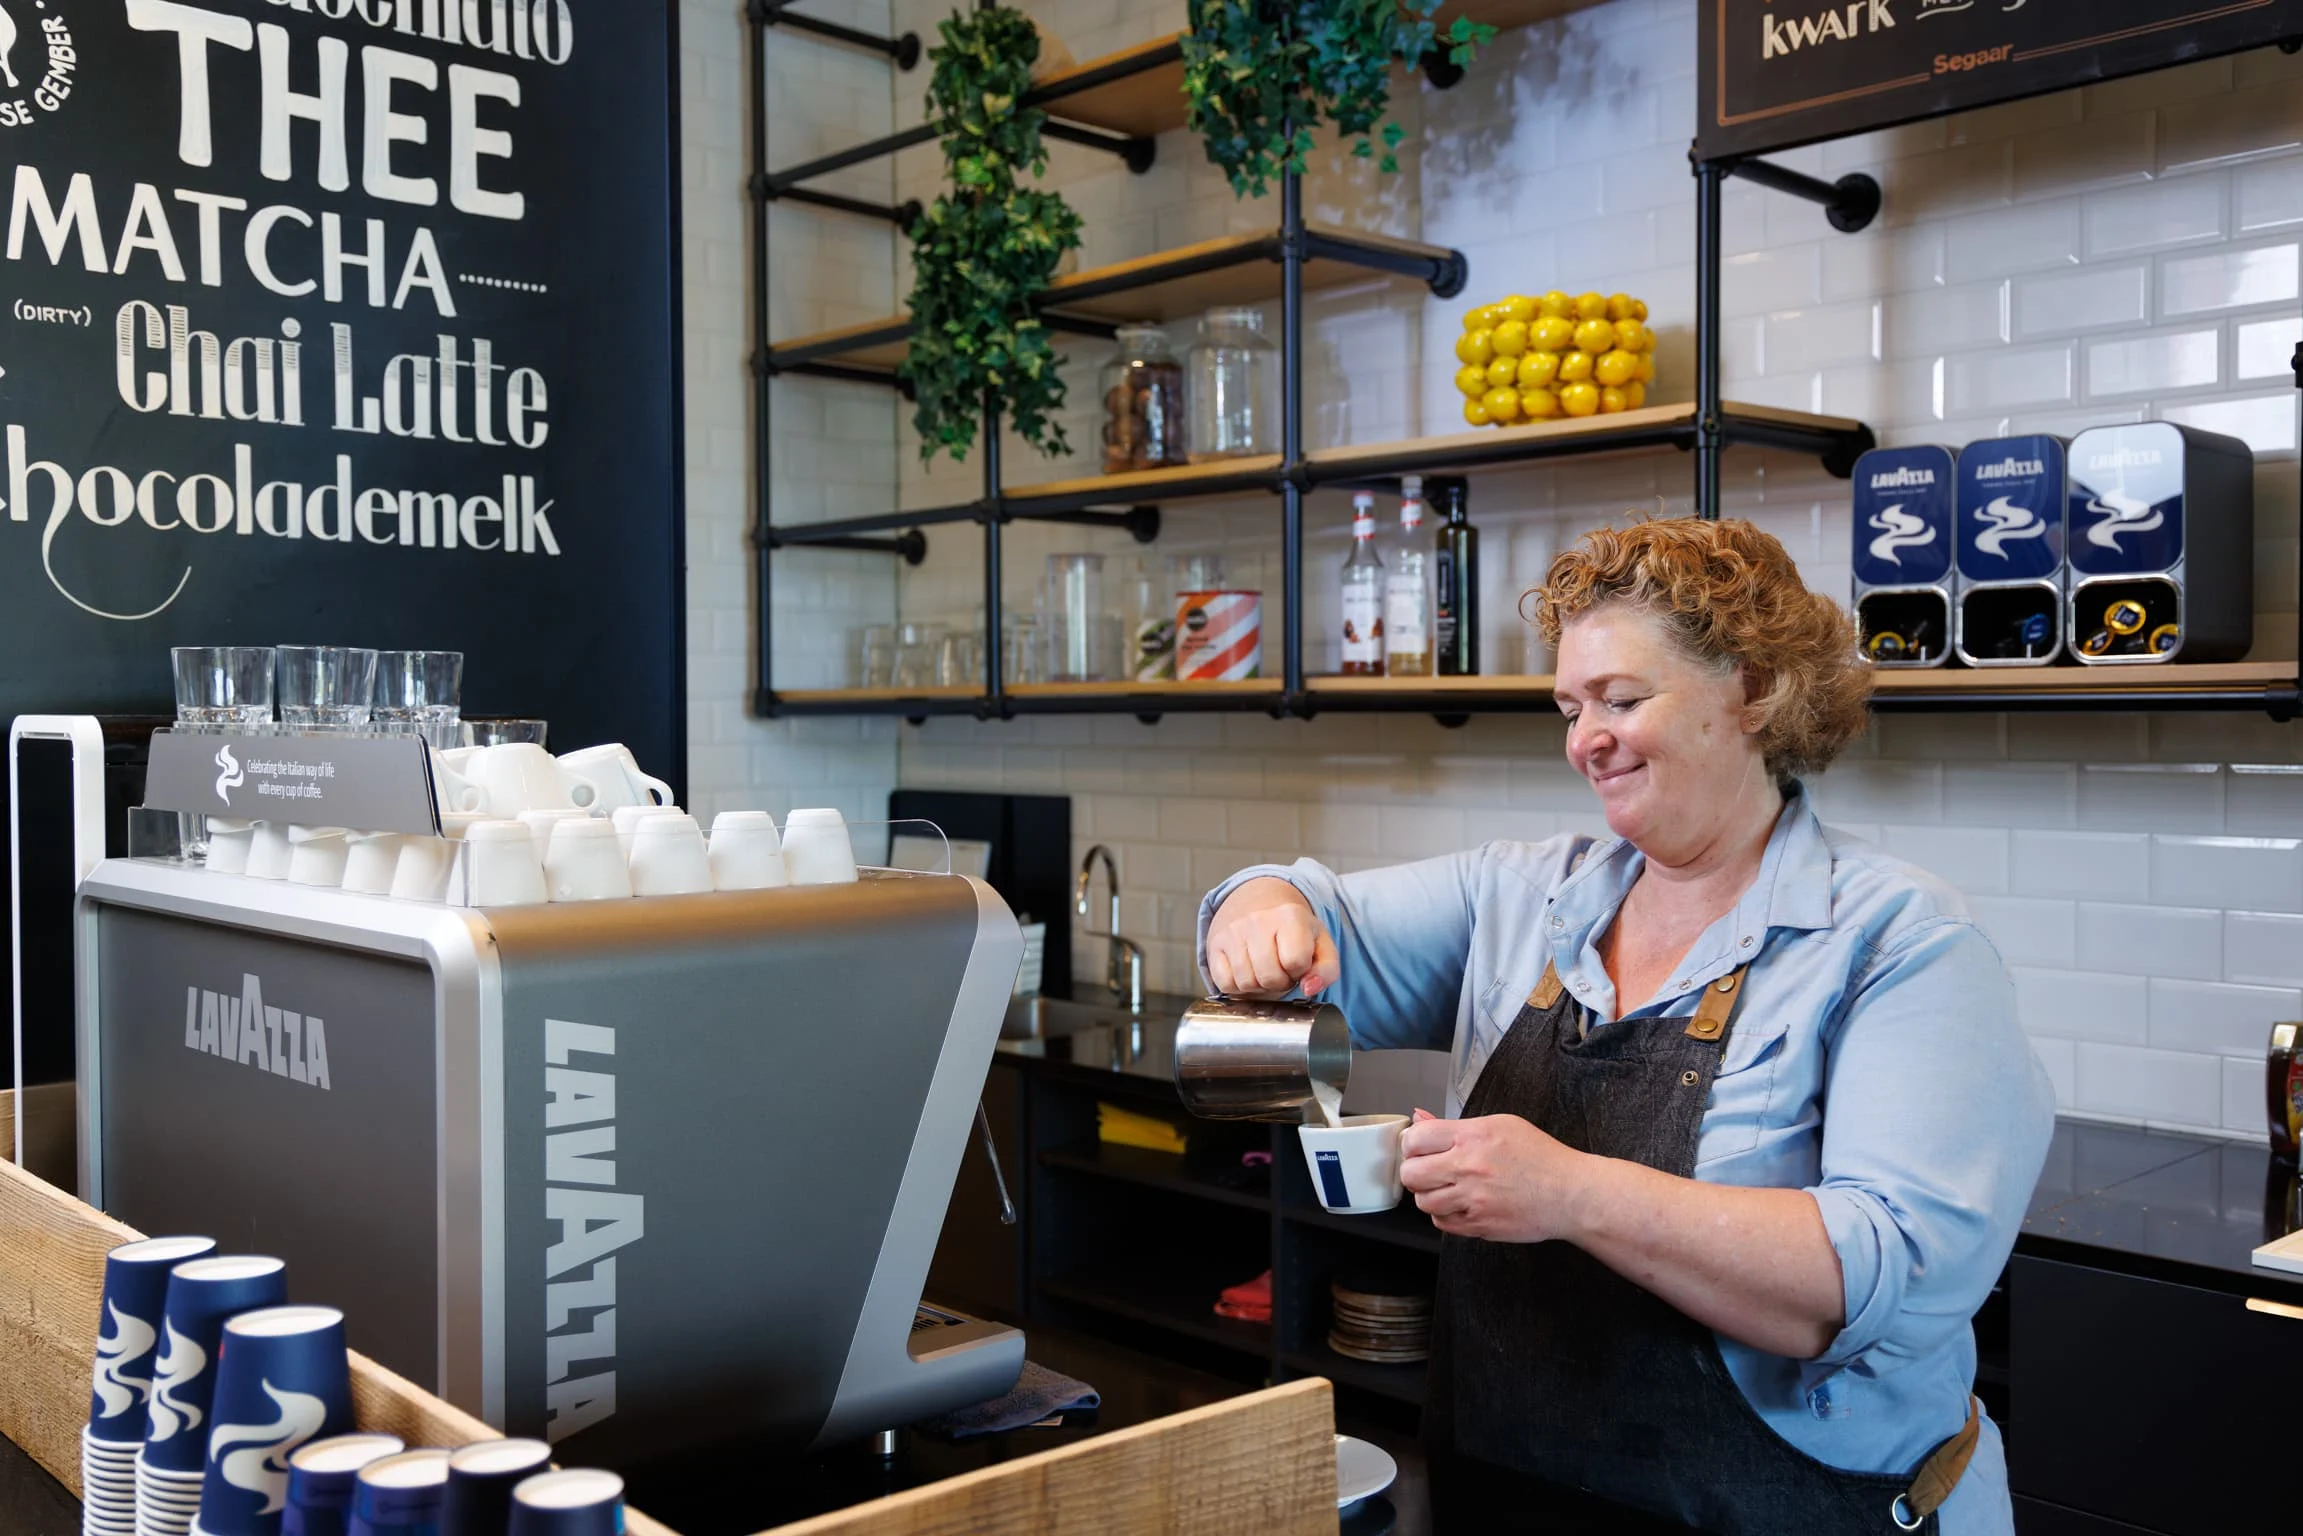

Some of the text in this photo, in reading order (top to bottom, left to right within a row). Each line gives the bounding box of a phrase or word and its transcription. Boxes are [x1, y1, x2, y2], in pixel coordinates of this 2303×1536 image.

[34, 15, 77, 112] GEMBER
[126, 0, 525, 220] THEE
[1933, 44, 2014, 74] Segaar
[6, 164, 457, 317] MATCHA
[14, 299, 92, 327] (DIRTY)
[116, 300, 549, 448] Chai Latte
[0, 424, 561, 619] hocolademelk
[1976, 457, 2044, 480] LAVAZZA
[247, 759, 277, 778] Celebrating
[278, 759, 287, 774] the
[305, 765, 317, 780] way
[318, 762, 325, 777] of
[325, 762, 335, 778] life
[258, 780, 270, 794] with
[271, 785, 285, 799] every
[286, 786, 296, 800] cup
[297, 782, 303, 796] of
[185, 973, 330, 1090] LAVAZZA
[545, 1019, 644, 1447] LAVAZZA
